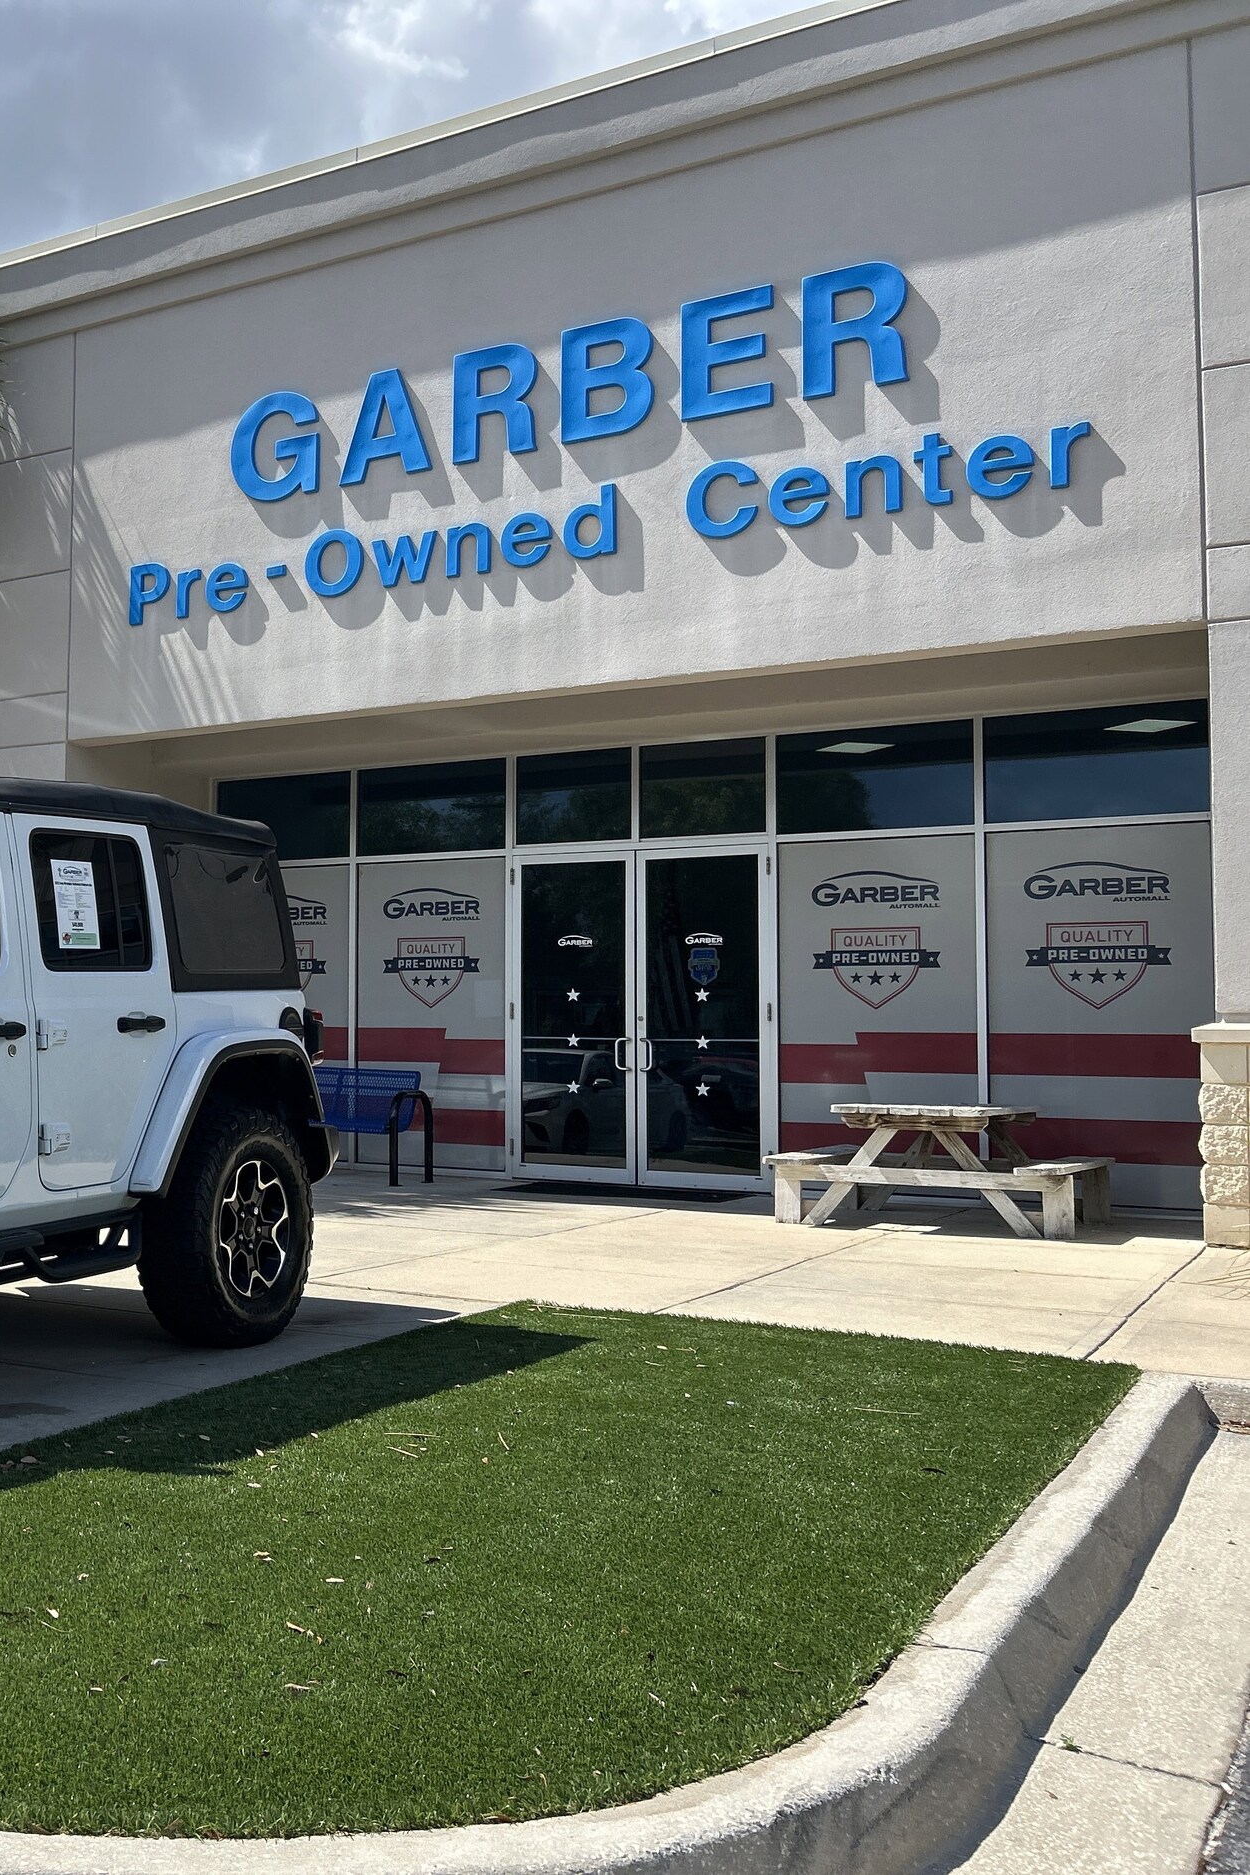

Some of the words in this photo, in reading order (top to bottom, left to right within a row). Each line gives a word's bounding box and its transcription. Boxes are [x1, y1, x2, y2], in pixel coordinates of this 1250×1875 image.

[230, 261, 909, 502] GARBER
[129, 483, 618, 626] Pre-Owned
[686, 421, 1092, 540] Center
[1023, 874, 1171, 900] GARBER
[811, 883, 940, 907] GARBER
[289, 906, 328, 920] BER
[383, 898, 481, 920] GARBER
[888, 902, 941, 910] AUTOMALL
[684, 936, 723, 945] GARBER
[843, 934, 908, 948] QUALITY
[1060, 929, 1134, 944] QUALITY
[406, 943, 456, 955] QUALITY
[1047, 948, 1149, 962] PRE-OWNED
[397, 958, 465, 969] PRE-OWNED
[831, 951, 921, 964] PRE-OWNED
